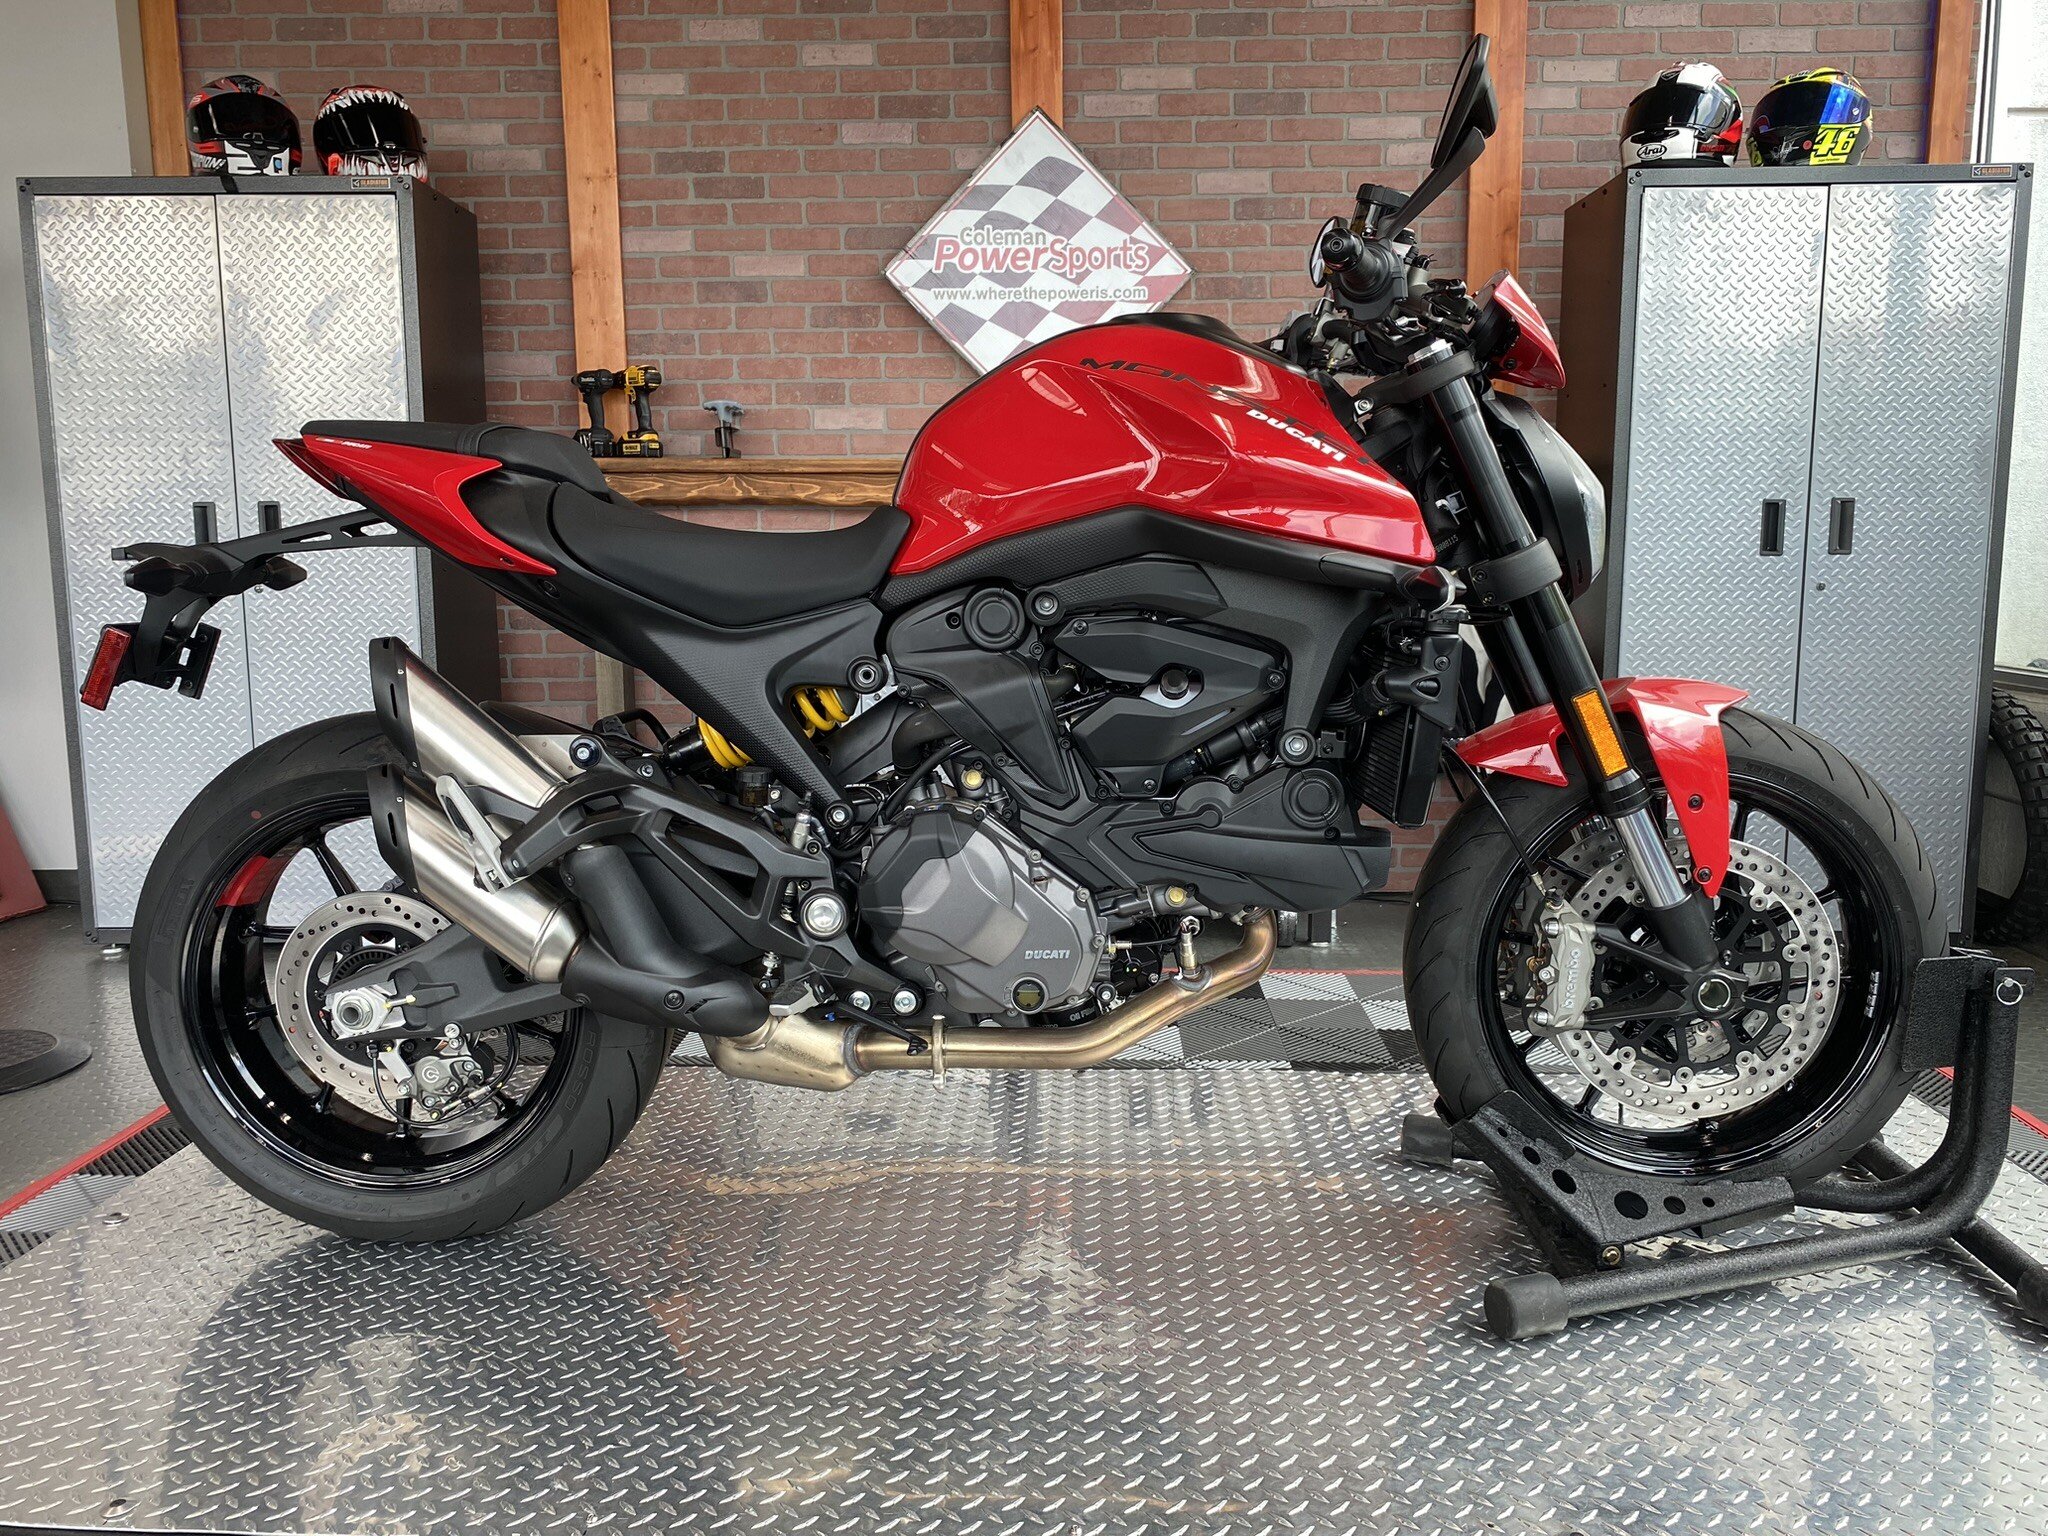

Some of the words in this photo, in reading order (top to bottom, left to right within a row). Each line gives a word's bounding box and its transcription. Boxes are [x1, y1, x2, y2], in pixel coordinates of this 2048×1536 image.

[1641, 146, 1663, 156] Arai
[1811, 126, 1861, 157] 46
[960, 226, 1047, 246] Coleman
[934, 237, 1149, 277] PowerSports
[933, 285, 1147, 302] www.wherethepoweris.com
[1246, 408, 1347, 462] DUCATI
[1025, 949, 1070, 960] DUCATI
[1560, 948, 1582, 1009] brembo
[1069, 1012, 1081, 1022] Oil
[566, 1031, 596, 1111] ROSSO
